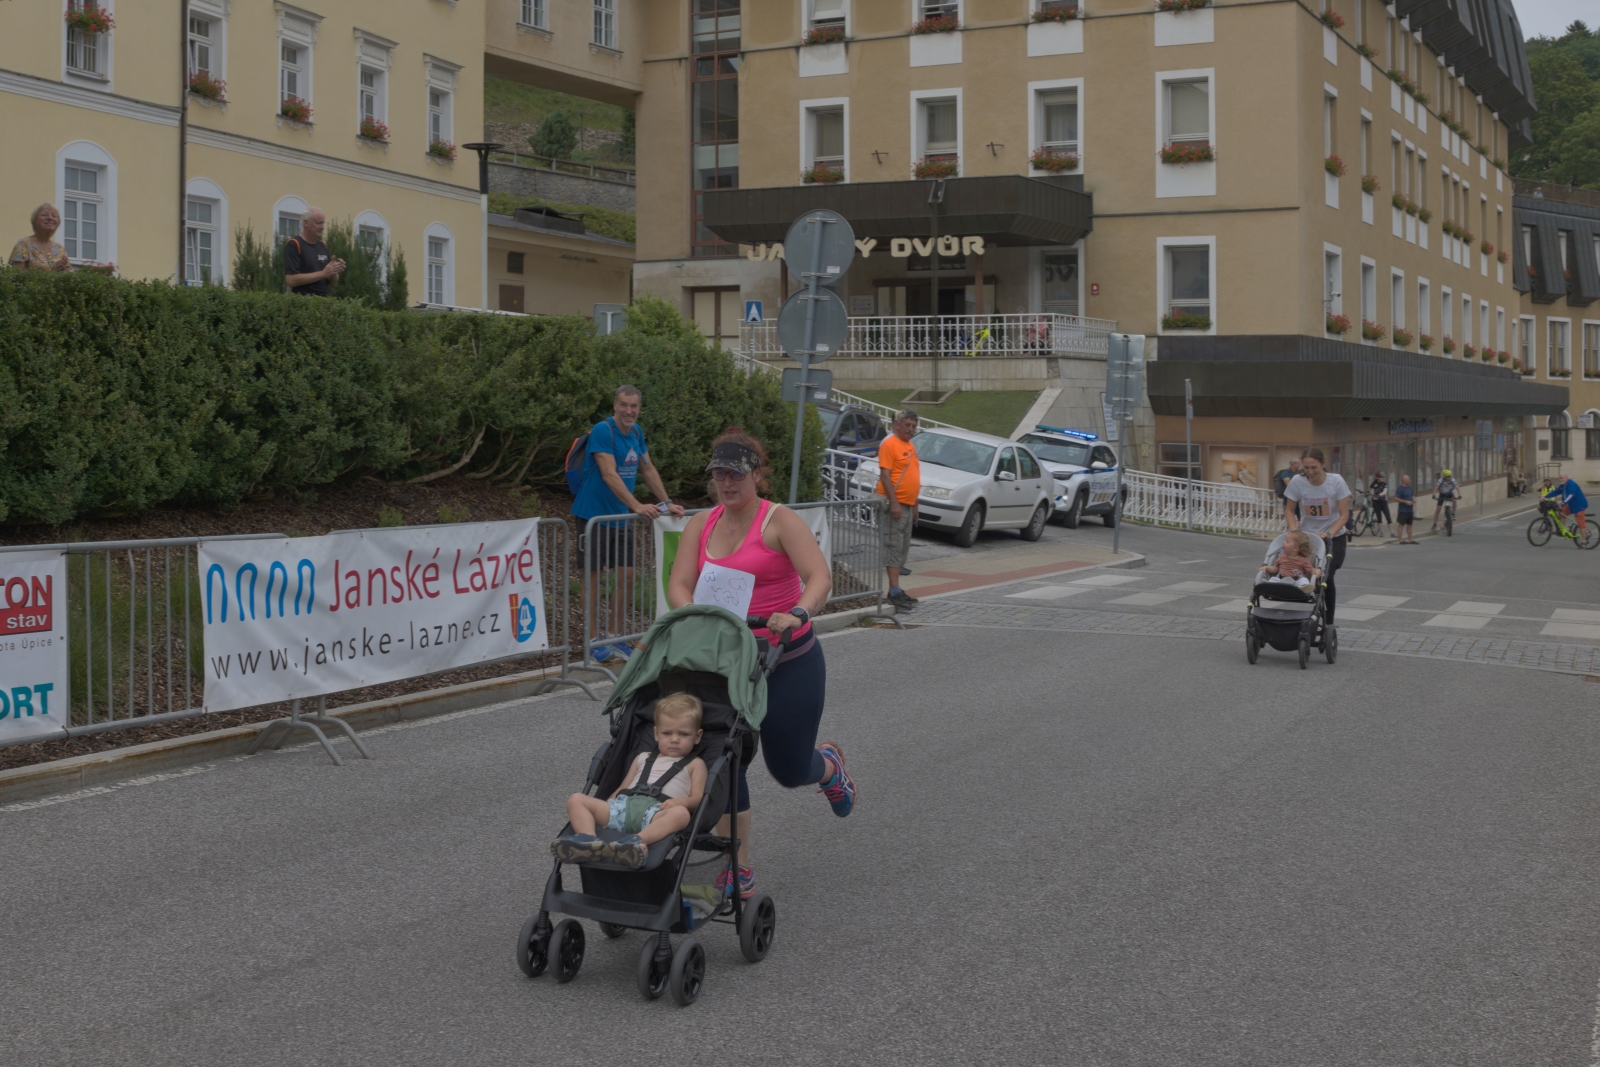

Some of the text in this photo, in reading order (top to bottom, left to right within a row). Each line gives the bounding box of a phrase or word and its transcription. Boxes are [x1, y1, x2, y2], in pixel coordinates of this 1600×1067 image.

[747, 234, 986, 262] JAÝ DVŮR
[1309, 504, 1323, 517] 31
[329, 547, 440, 613] Janské
[6, 613, 48, 629] stav
[21, 637, 53, 651] Úpice
[211, 612, 502, 680] www.janske-lazne.cz
